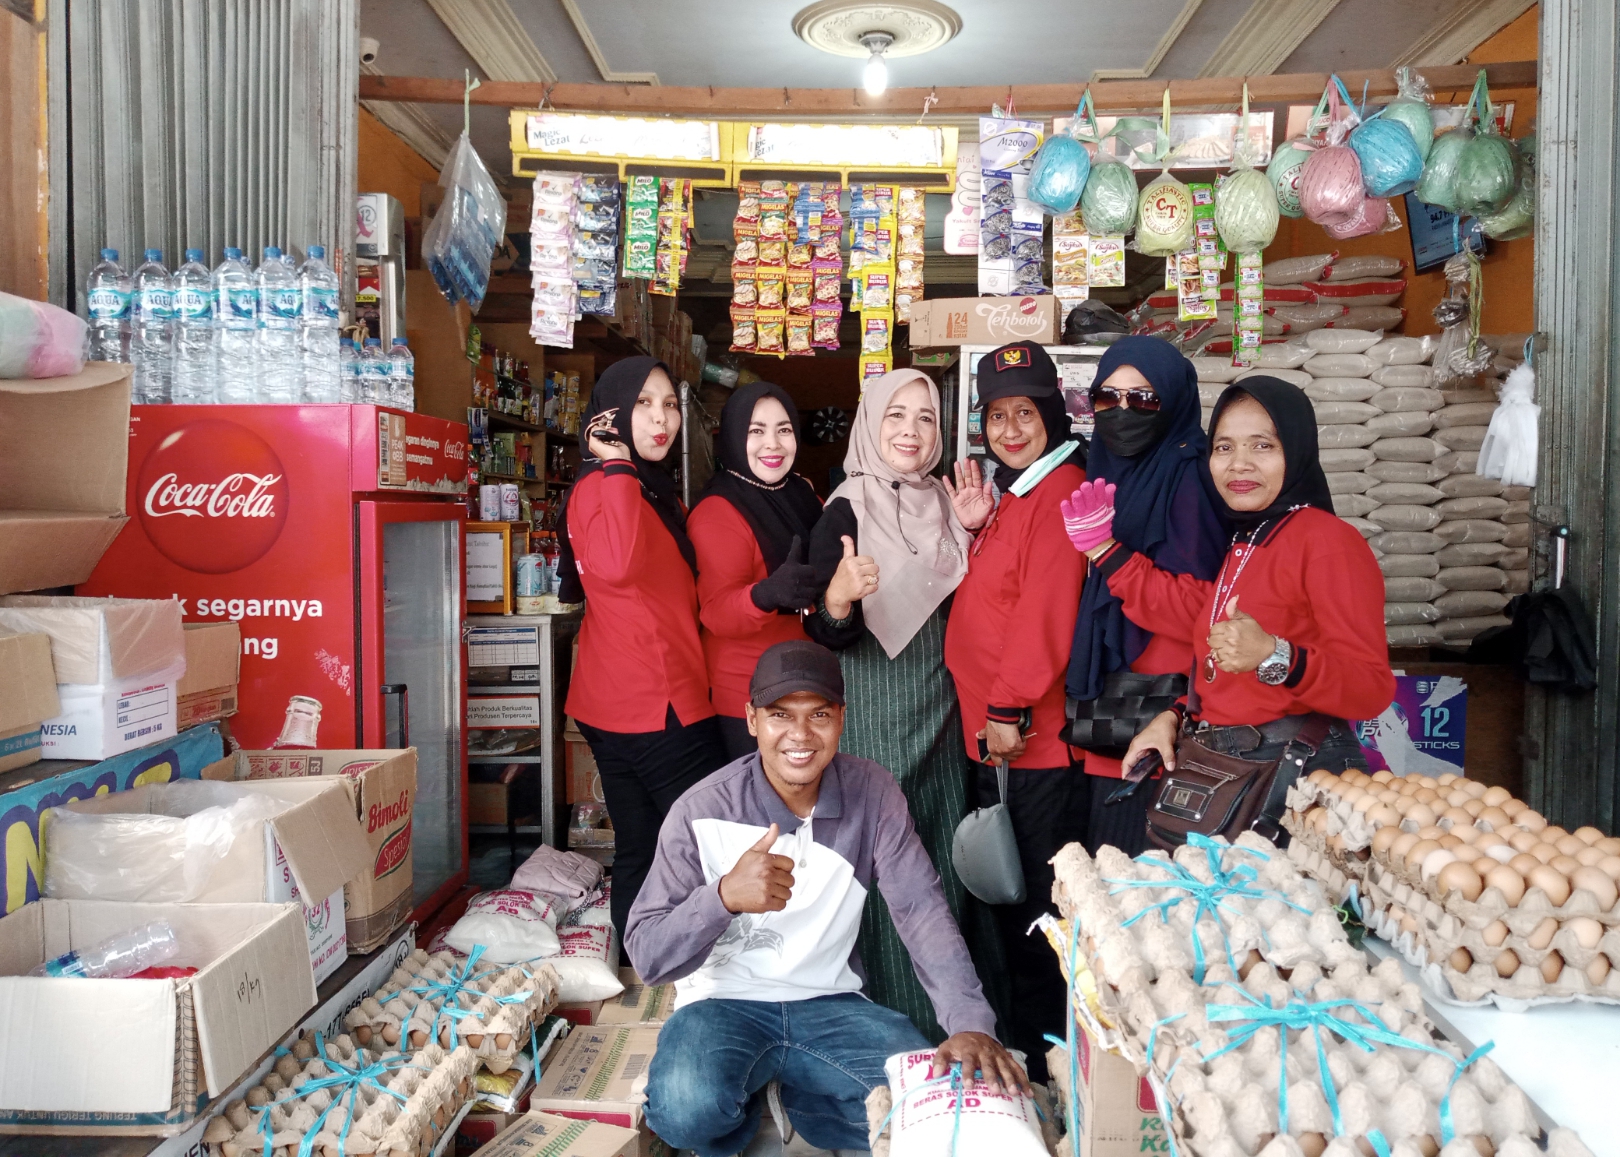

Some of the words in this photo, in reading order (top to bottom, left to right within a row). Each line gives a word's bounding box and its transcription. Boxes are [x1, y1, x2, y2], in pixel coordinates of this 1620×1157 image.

[533, 129, 561, 140] Magic
[91, 295, 120, 306] AQUA
[954, 312, 968, 325] 24
[144, 472, 283, 518] Coca-Cola
[196, 598, 323, 621] segarnya
[1420, 706, 1450, 738] 12
[1413, 741, 1461, 750] STICKS
[367, 790, 409, 834] Bimoli
